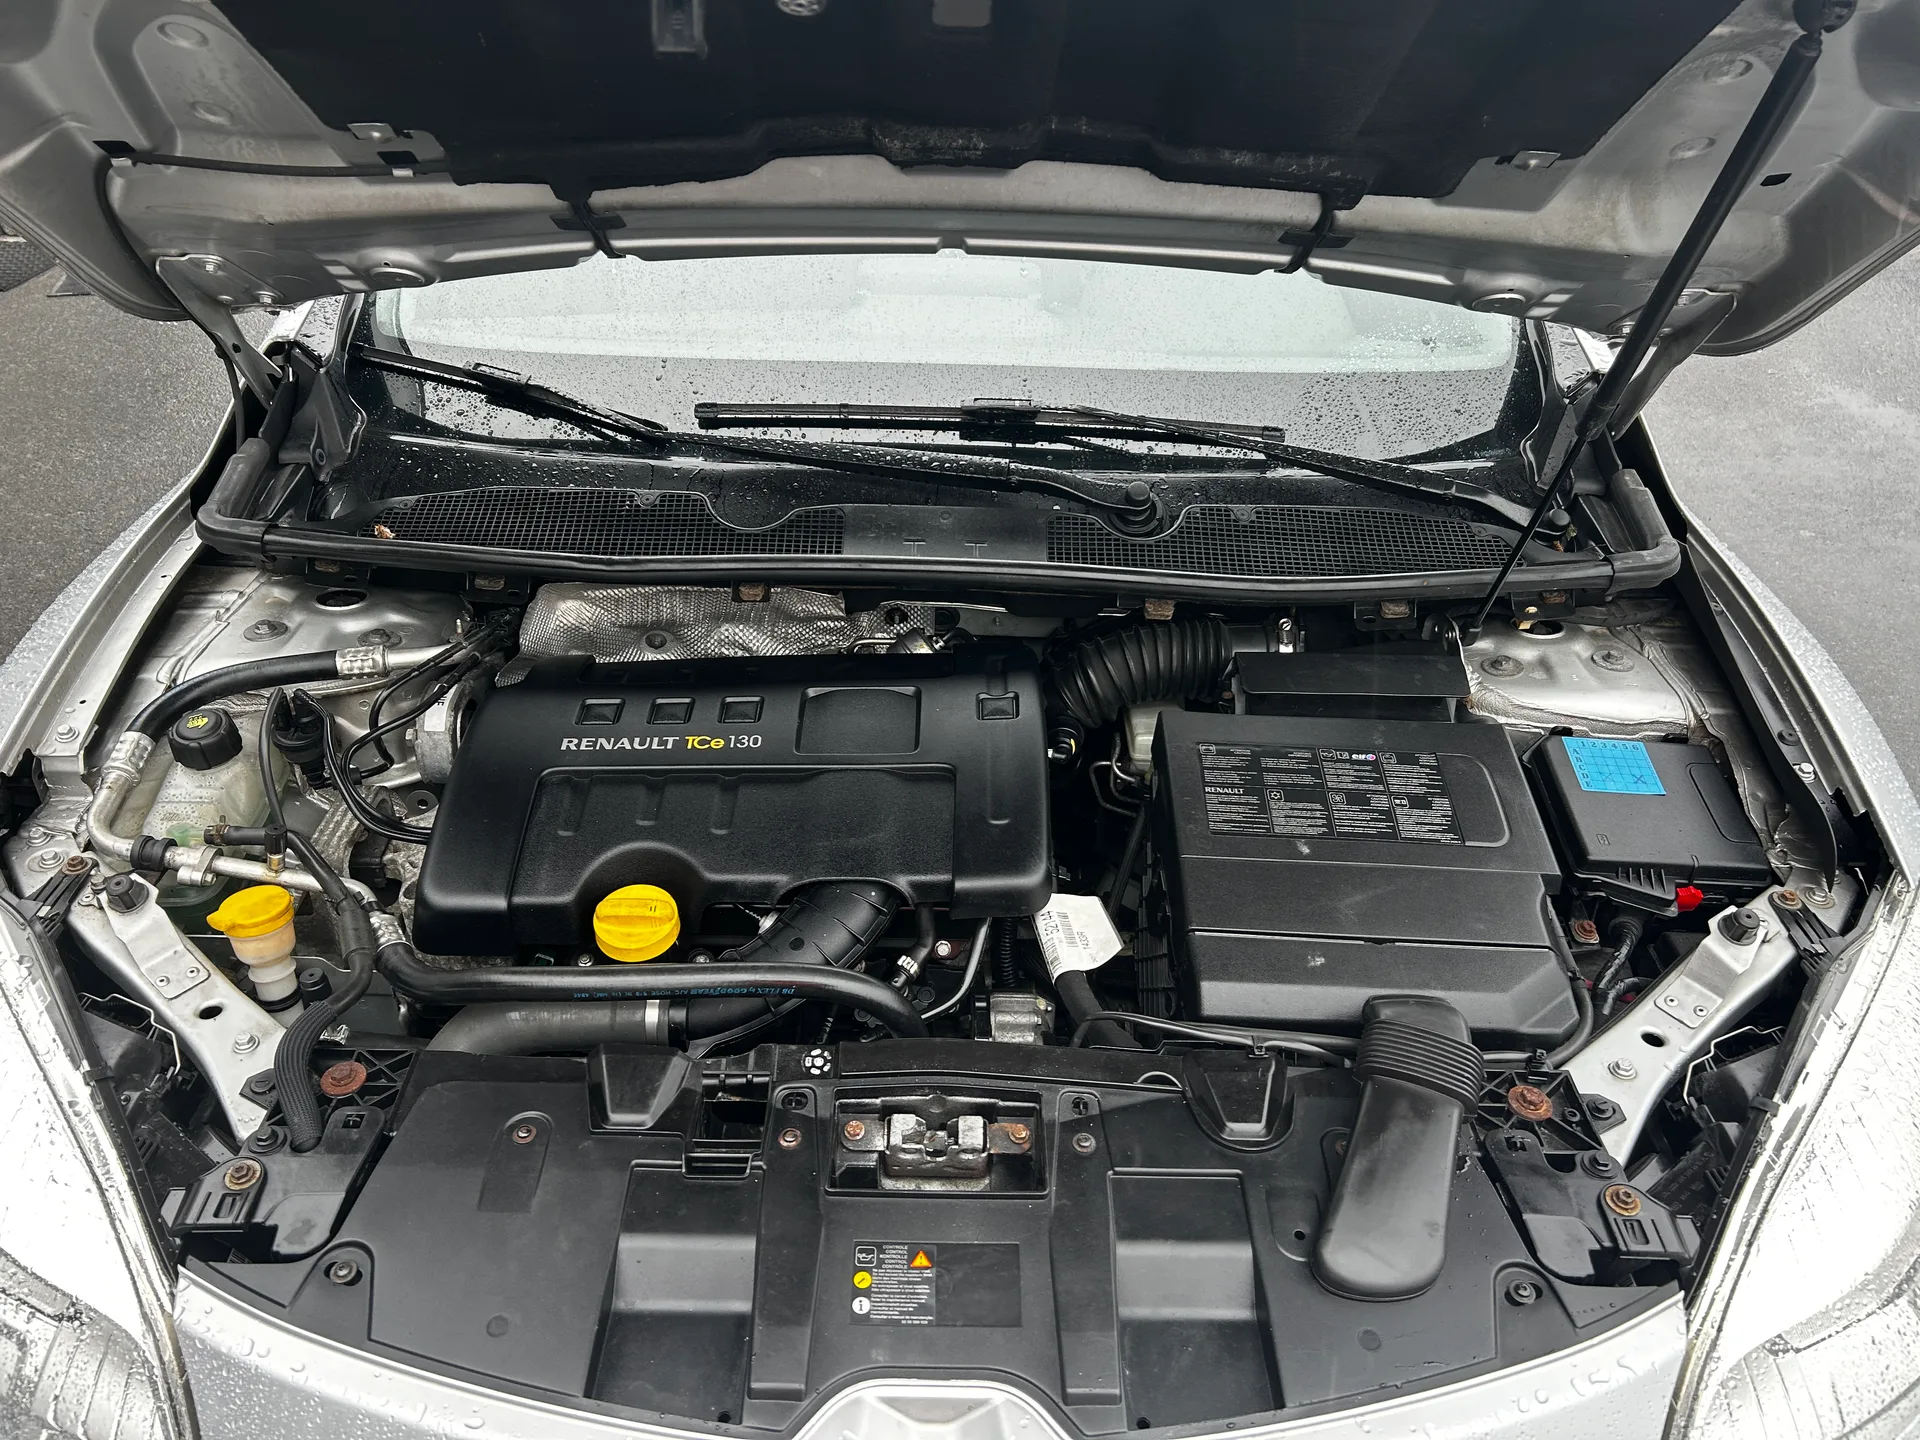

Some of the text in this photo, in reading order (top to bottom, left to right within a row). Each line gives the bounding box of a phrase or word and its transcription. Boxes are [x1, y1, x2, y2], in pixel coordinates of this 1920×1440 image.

[560, 735, 762, 750] RENAULT TCe 130
[1205, 786, 1245, 794] RENAULT
